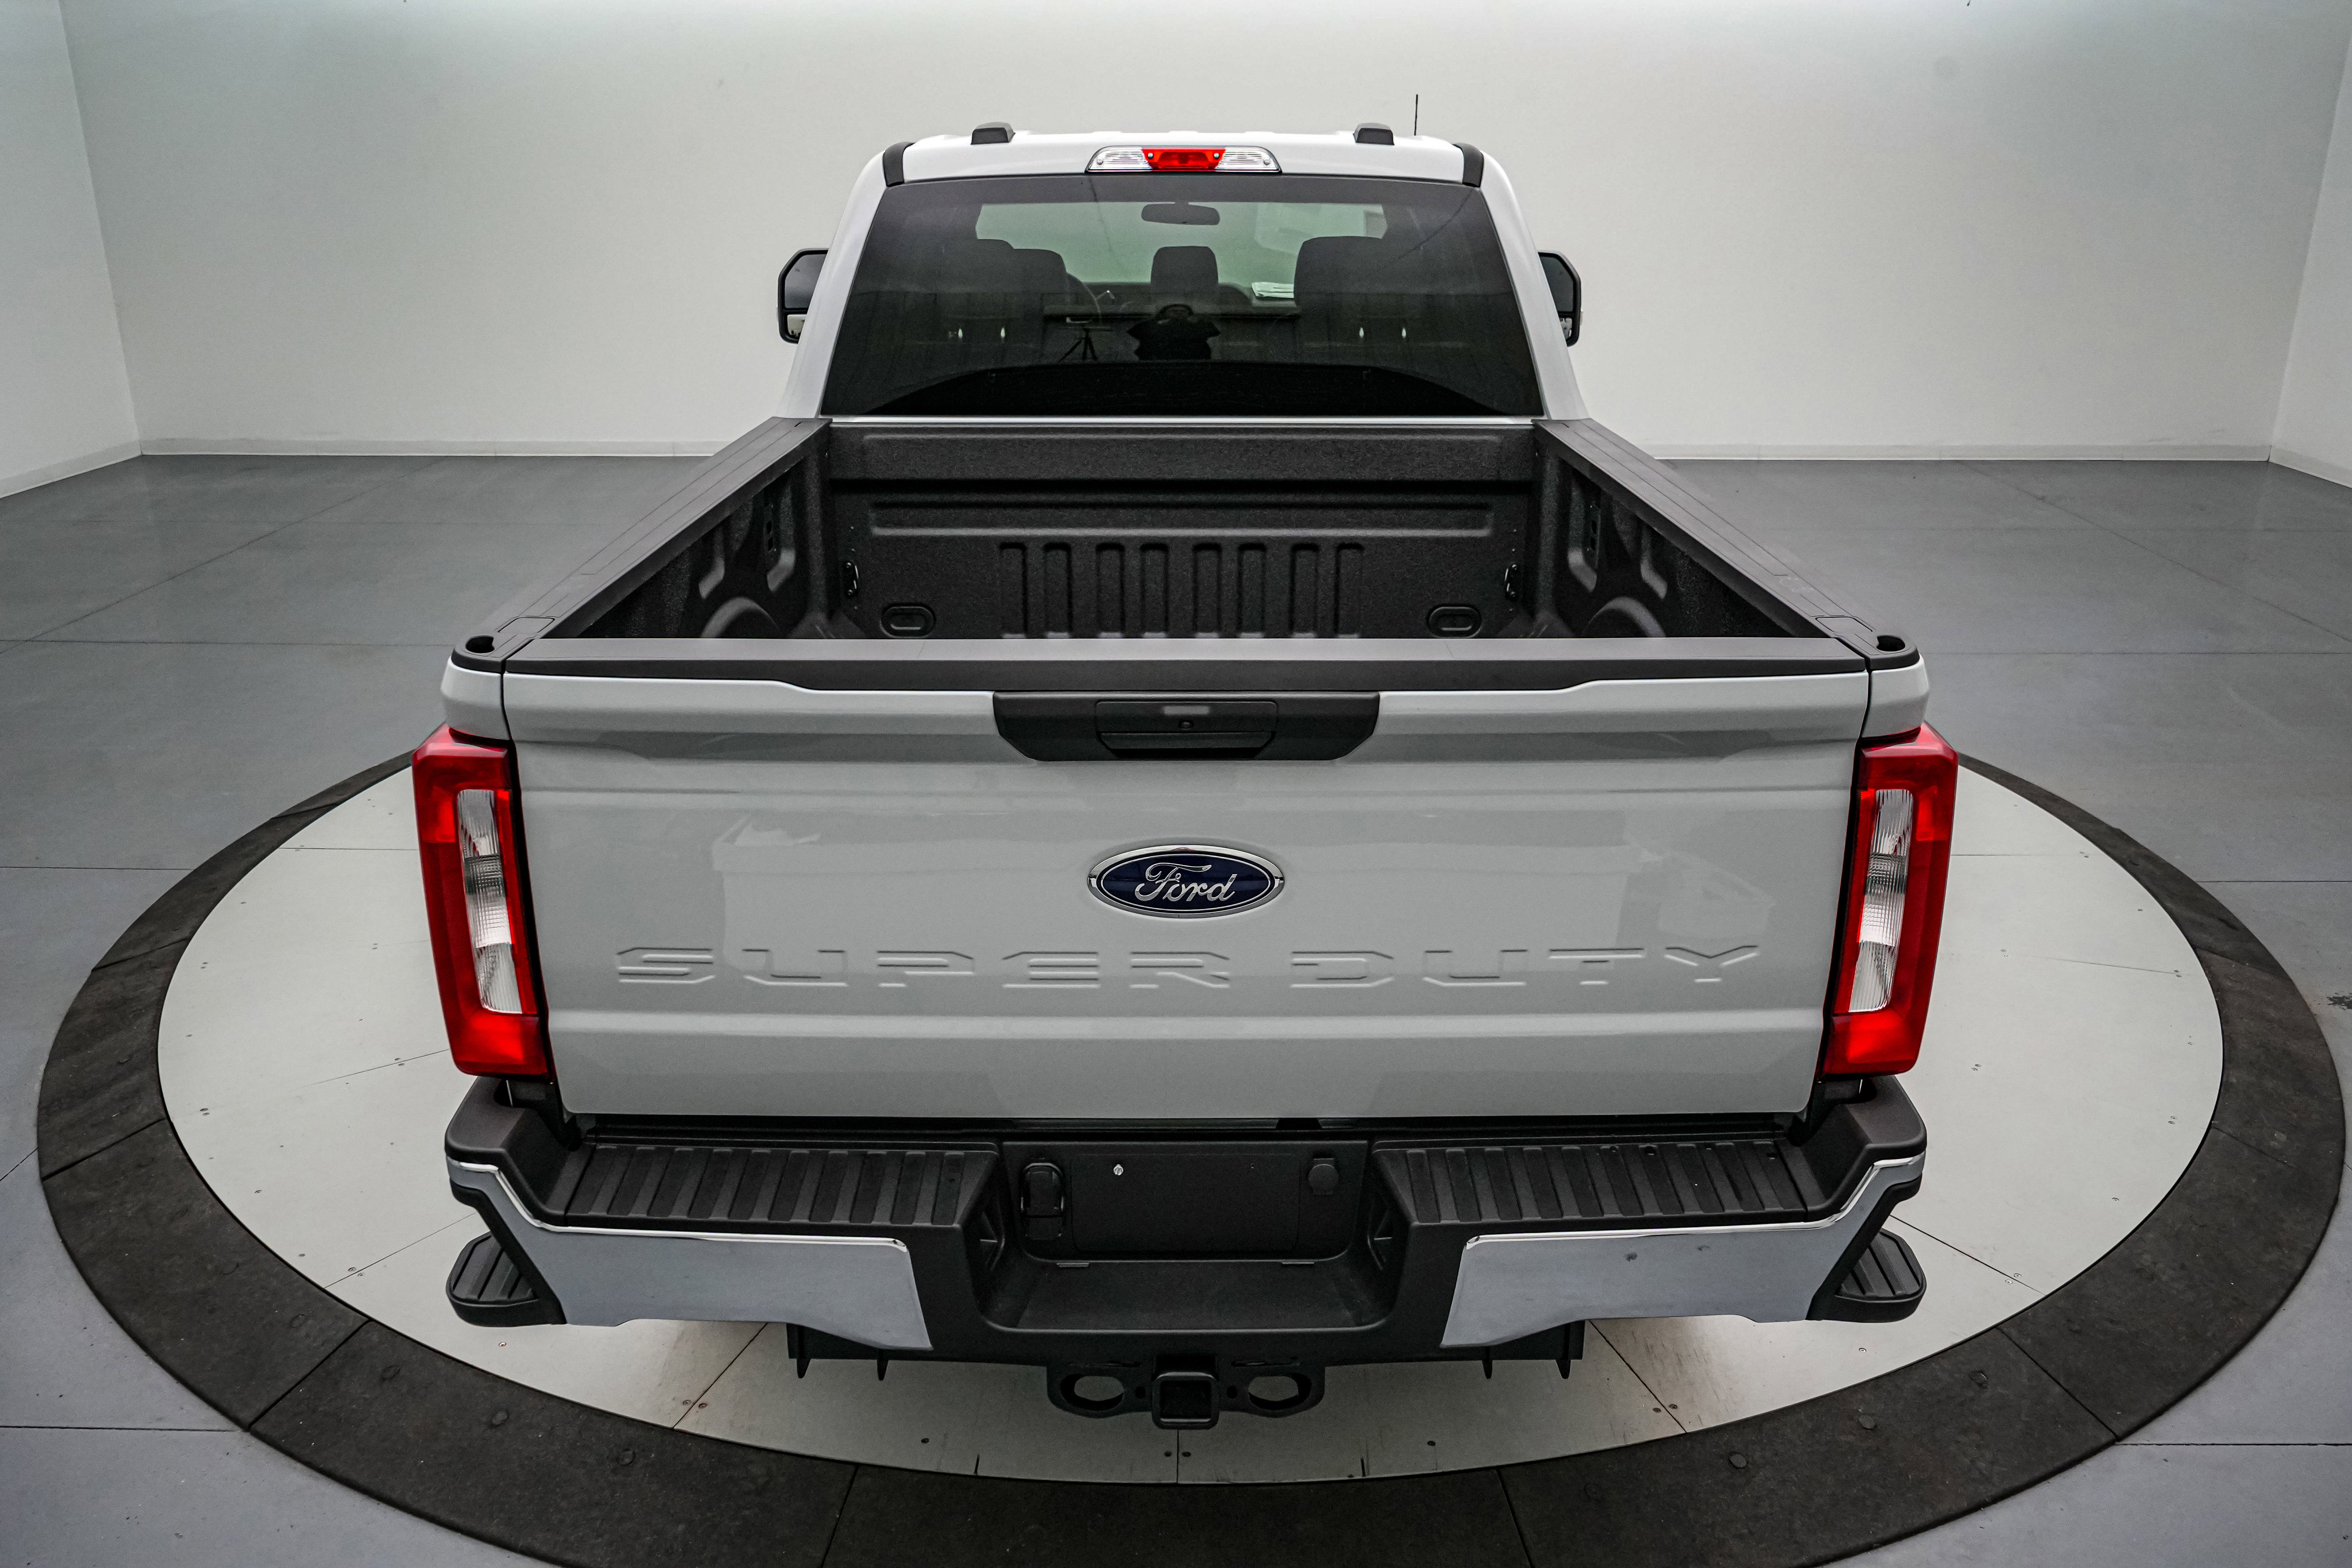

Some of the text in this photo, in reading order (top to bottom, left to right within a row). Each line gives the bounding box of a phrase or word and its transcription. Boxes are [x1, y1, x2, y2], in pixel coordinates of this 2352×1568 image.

[1134, 862, 1237, 902] Ford
[616, 945, 1760, 989] SUPER DUTY
